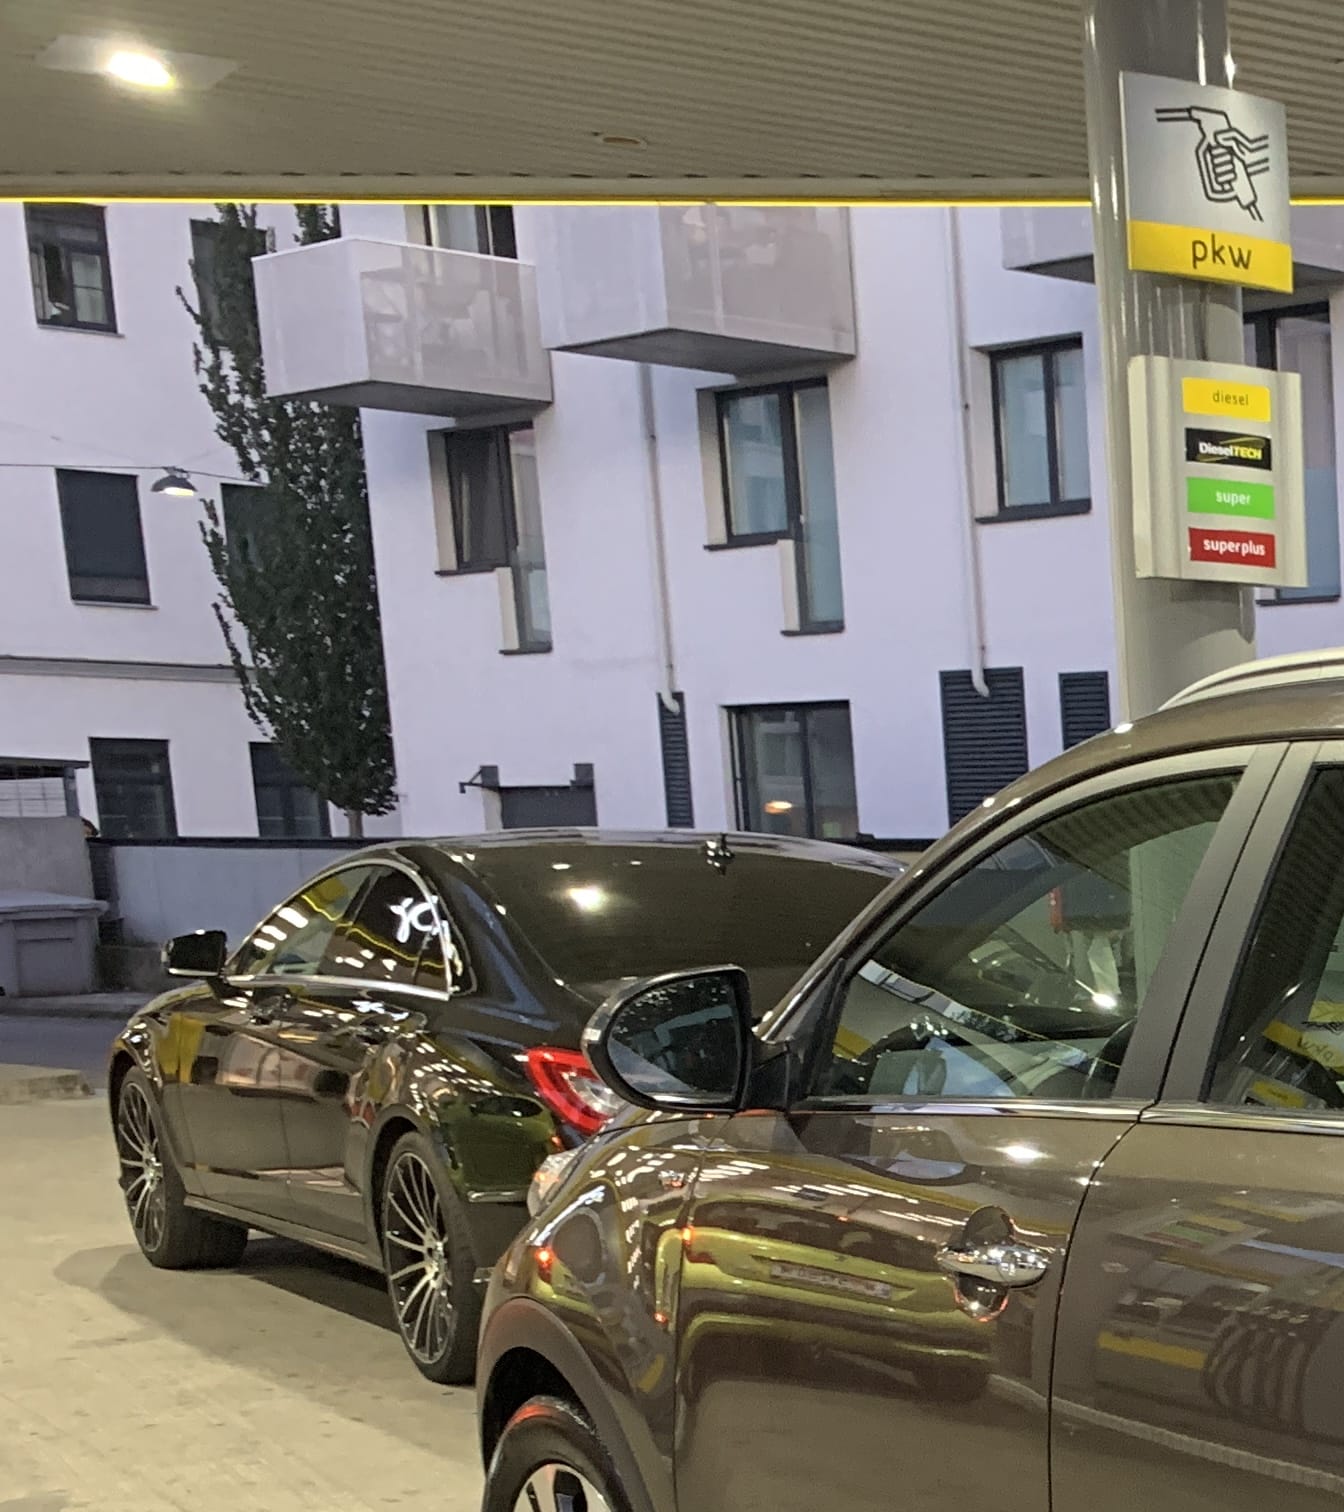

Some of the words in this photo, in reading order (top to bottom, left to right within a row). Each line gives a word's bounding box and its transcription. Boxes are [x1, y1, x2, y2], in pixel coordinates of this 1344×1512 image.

[1191, 234, 1252, 271] pkw
[1212, 389, 1249, 406] diesel
[1215, 490, 1251, 507] super
[1203, 539, 1266, 557] superplus
